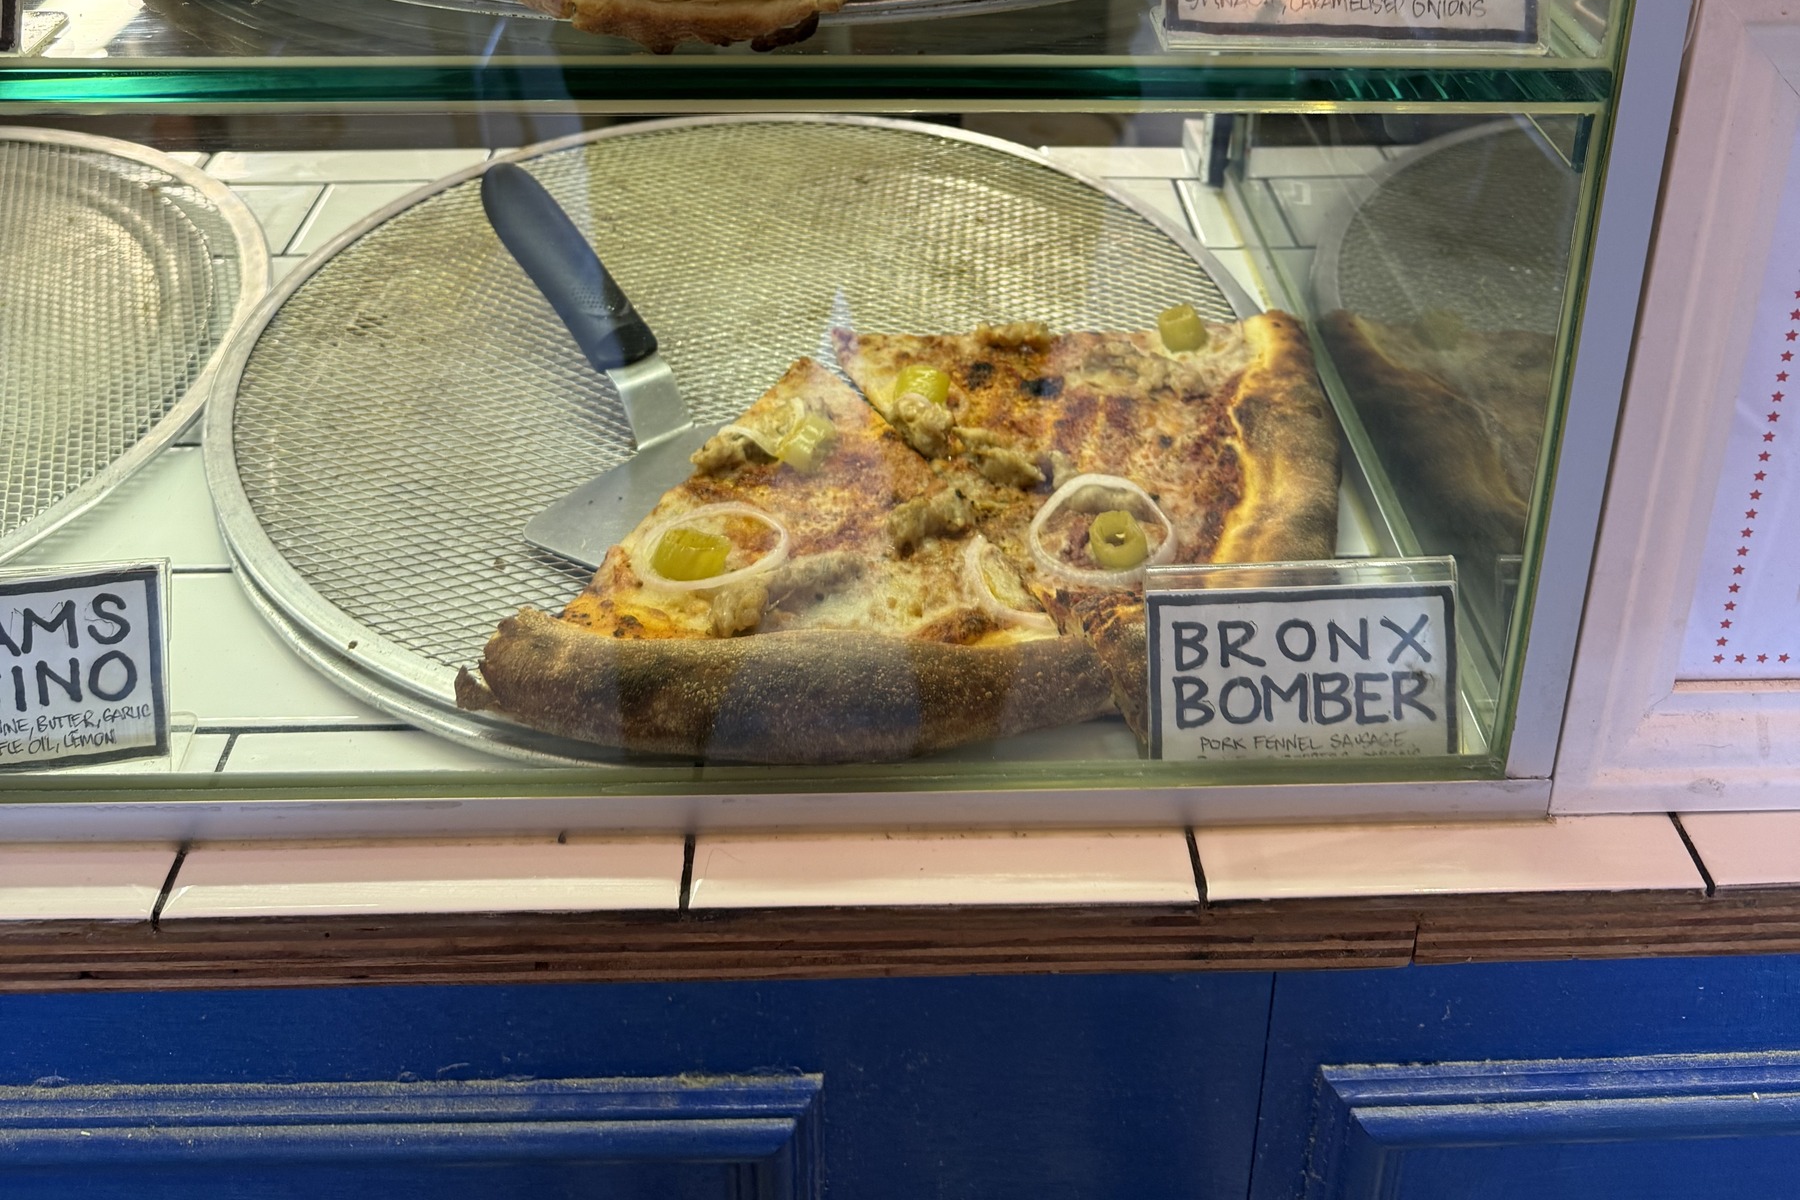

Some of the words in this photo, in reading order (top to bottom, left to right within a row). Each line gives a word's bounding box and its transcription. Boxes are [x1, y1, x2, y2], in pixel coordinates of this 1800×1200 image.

[1171, 613, 1433, 672] BRONX
[1171, 671, 1438, 730] BOMBER
[37, 710, 101, 733] BUTTER,
[102, 704, 151, 723] GARLIC
[63, 729, 117, 748] LEMON
[1199, 736, 1247, 752] PORK
[1252, 734, 1323, 751] FENNEL
